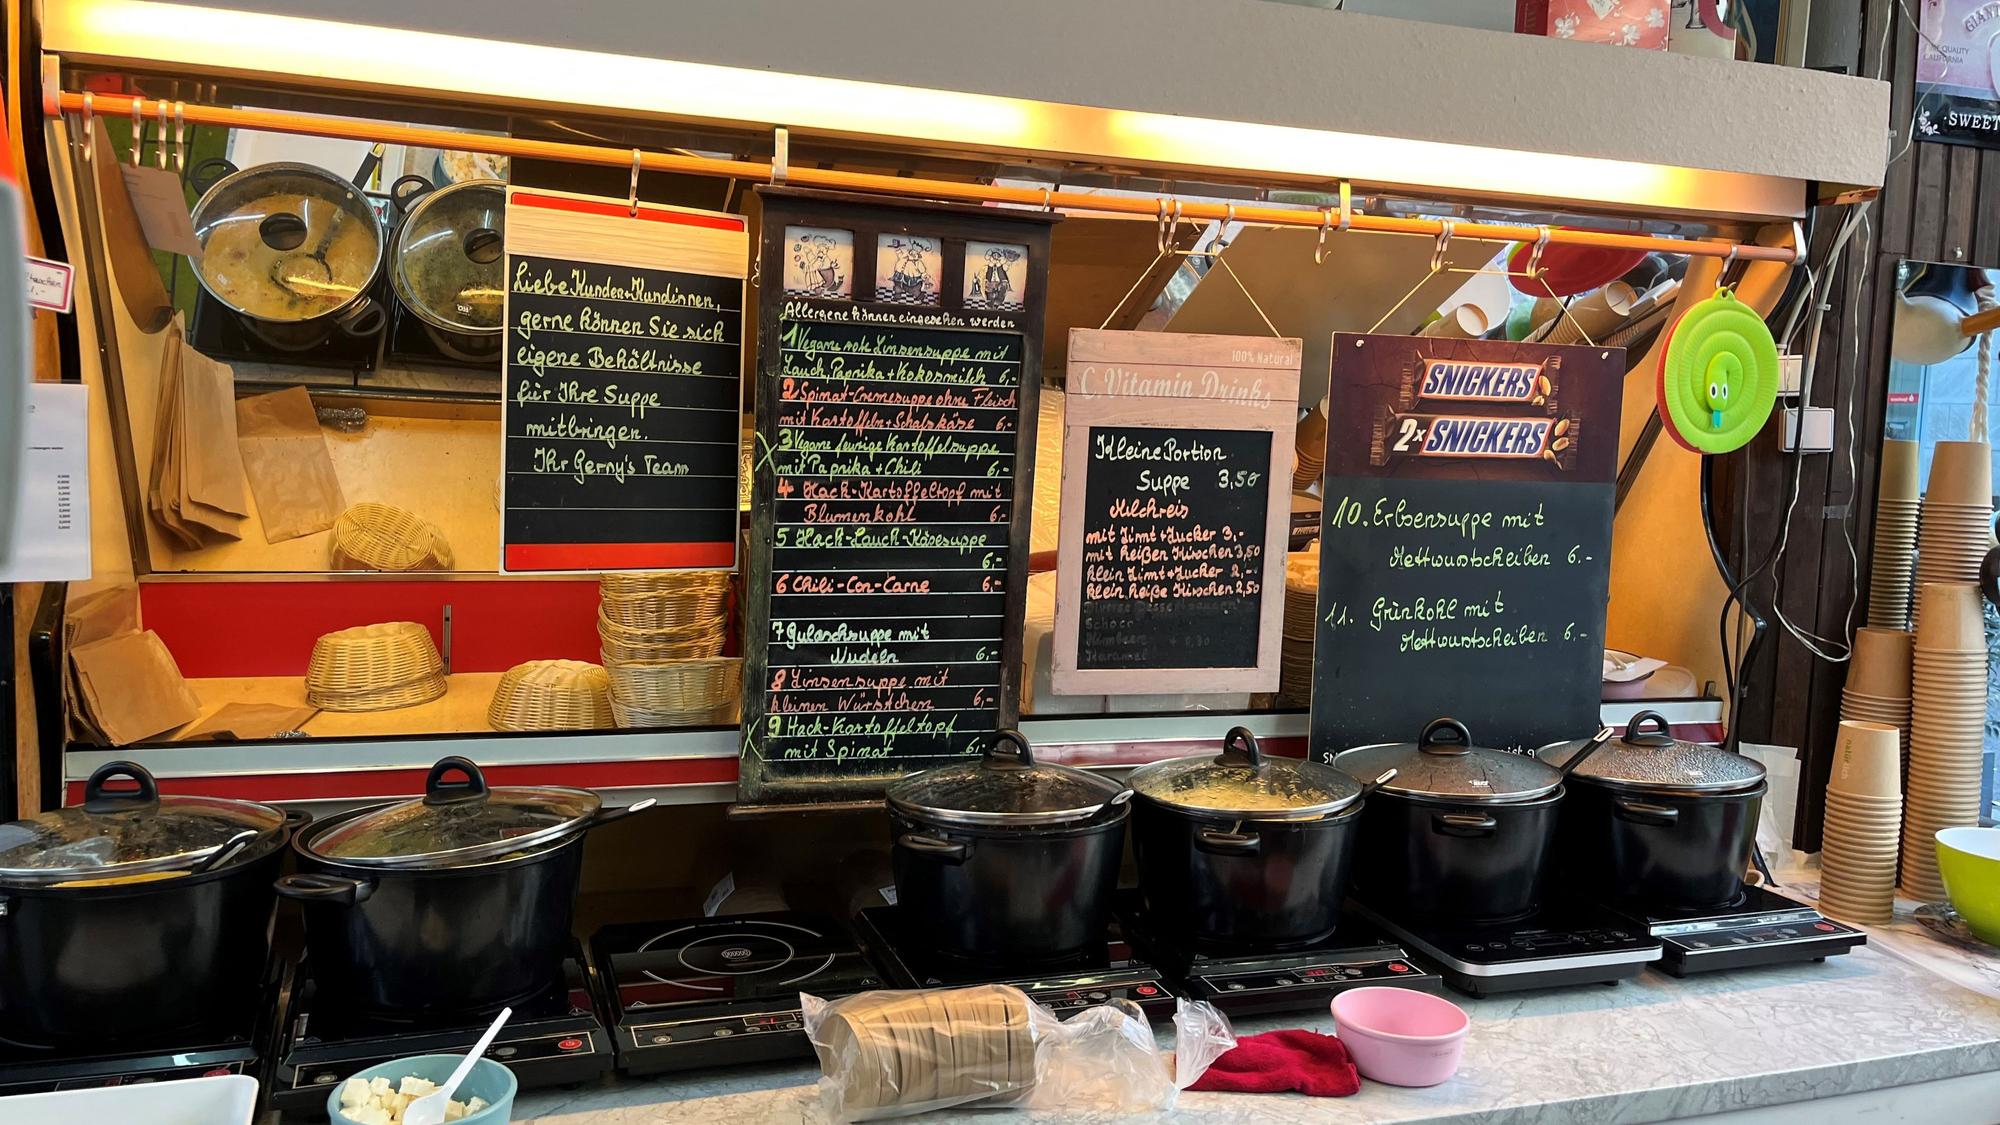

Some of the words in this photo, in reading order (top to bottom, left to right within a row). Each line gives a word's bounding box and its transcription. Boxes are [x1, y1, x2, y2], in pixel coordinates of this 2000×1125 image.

[513, 261, 569, 295] Liebe
[518, 311, 574, 340] gerne
[579, 306, 645, 335] können
[650, 315, 680, 339] Sie
[683, 320, 725, 343] sich
[783, 301, 850, 322] Allergene
[850, 306, 898, 323] können
[898, 307, 966, 328] eingesehen
[969, 313, 1016, 329] werden
[517, 344, 582, 377] eigene
[587, 346, 703, 375] Behältnisse
[872, 333, 972, 367] Linsensuppe
[974, 345, 1010, 361] mit
[1231, 350, 1254, 363] 100%
[1256, 351, 1293, 366] Natural
[782, 378, 800, 400] 2
[935, 389, 969, 407] ohne
[971, 387, 1017, 408] Fleisch
[1104, 367, 1194, 399] Vitamin
[1195, 370, 1273, 409] Drinks
[1425, 363, 1537, 399] SNICKERS
[516, 379, 551, 408] für
[557, 380, 600, 404] Ihre
[603, 384, 661, 420] Suppe
[779, 405, 807, 426] mit
[526, 412, 649, 449] mitbringen.
[1393, 418, 1427, 452] 2x
[1428, 418, 1548, 455] SNICKERS
[778, 428, 793, 450] 3
[886, 432, 1001, 462] Kartoffelsuppe
[1164, 437, 1228, 462] Portion
[533, 447, 569, 473] Ihr
[643, 454, 690, 476] Team
[776, 460, 807, 476] mit
[807, 453, 871, 481] Paprika
[802, 480, 967, 507] Hack-Kartoffeltopf
[969, 483, 1002, 499] mit
[1136, 470, 1191, 496] Suppe
[803, 503, 917, 523] Blumenkohl
[1109, 497, 1189, 519] Milchreis
[1332, 496, 1368, 529] 10.
[1372, 497, 1492, 540] Erbsensuppe
[1502, 502, 1545, 528] mit
[776, 527, 790, 547] 5
[1086, 524, 1116, 544] mit
[1120, 525, 1157, 544] Zimt
[1086, 545, 1113, 562] mit
[1120, 545, 1168, 566] heißen
[1172, 543, 1234, 562] Kirschen
[775, 574, 790, 593] 6
[792, 574, 930, 594] Chili-Con-Carne
[1086, 564, 1125, 583] klein
[1086, 583, 1125, 600] klein
[1128, 582, 1168, 603] heiße
[1172, 580, 1234, 599] Kirschen
[1325, 602, 1354, 628] 11.
[1370, 596, 1457, 632] Grünkohl
[1464, 590, 1505, 619] mit
[772, 621, 784, 641] 7
[786, 621, 892, 650] Gulaschsuppe
[898, 622, 930, 641] mit
[830, 646, 900, 665] Nudeln
[771, 668, 787, 692] 8
[790, 668, 907, 698] Linsensuppe
[914, 668, 950, 687] mit
[770, 692, 829, 714] kleinen
[838, 691, 936, 712] Würstchen
[768, 715, 782, 738] 9
[787, 713, 959, 745] Hack-Kartoffeltopf
[784, 741, 818, 759] mit
[825, 739, 894, 766] Spinat
